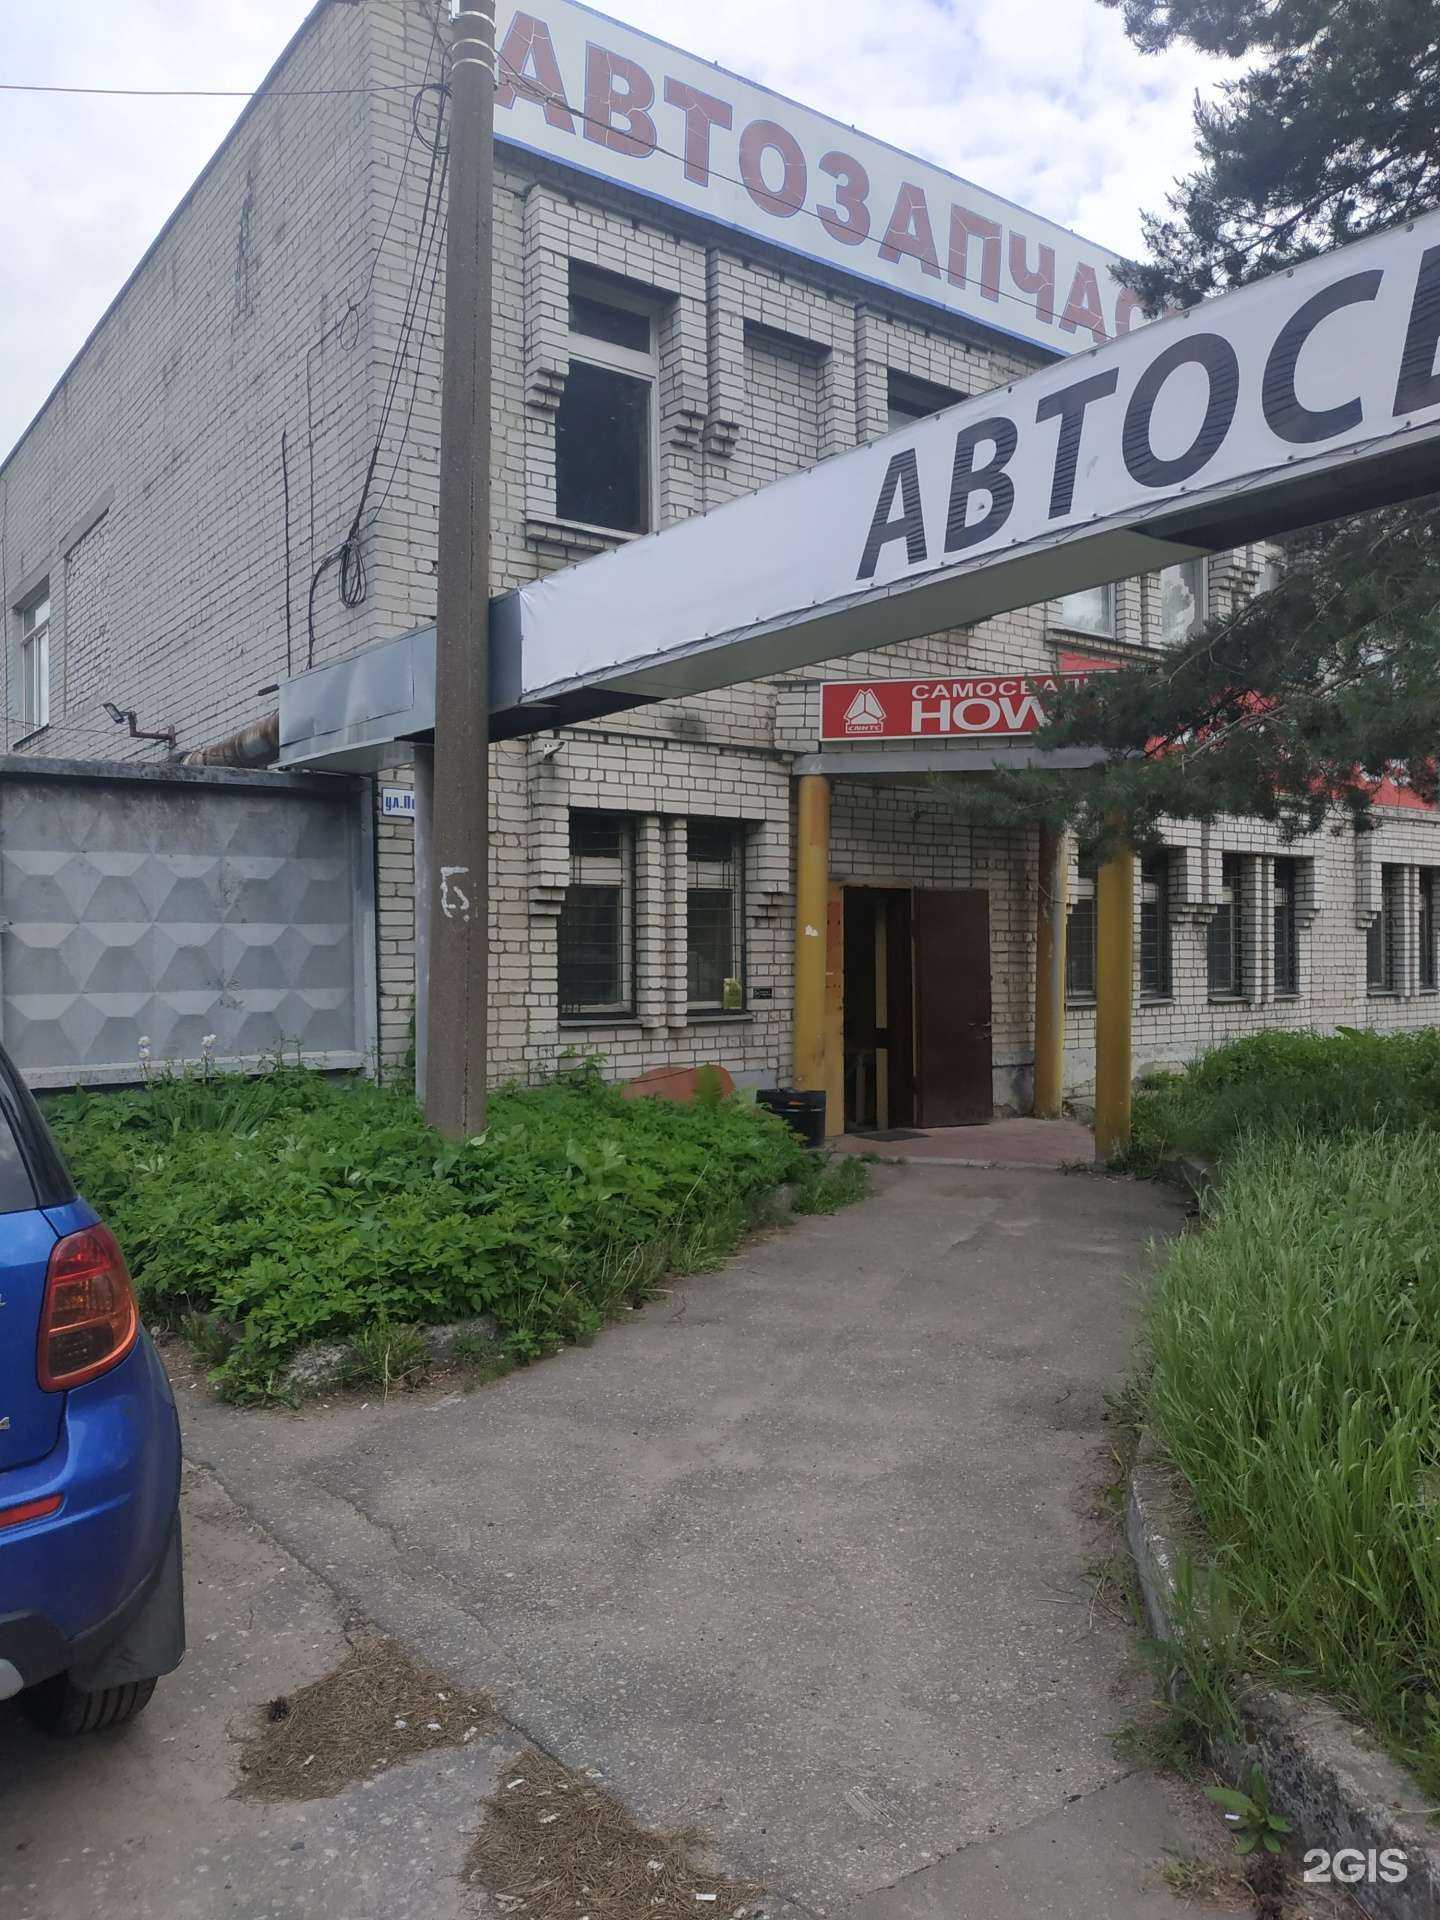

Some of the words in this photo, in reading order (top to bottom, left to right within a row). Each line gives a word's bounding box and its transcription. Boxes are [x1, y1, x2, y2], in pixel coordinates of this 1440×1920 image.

[911, 678, 1089, 700] САМОСВАЛ
[910, 695, 1052, 734] HOW
[385, 795, 416, 812] ул.П
